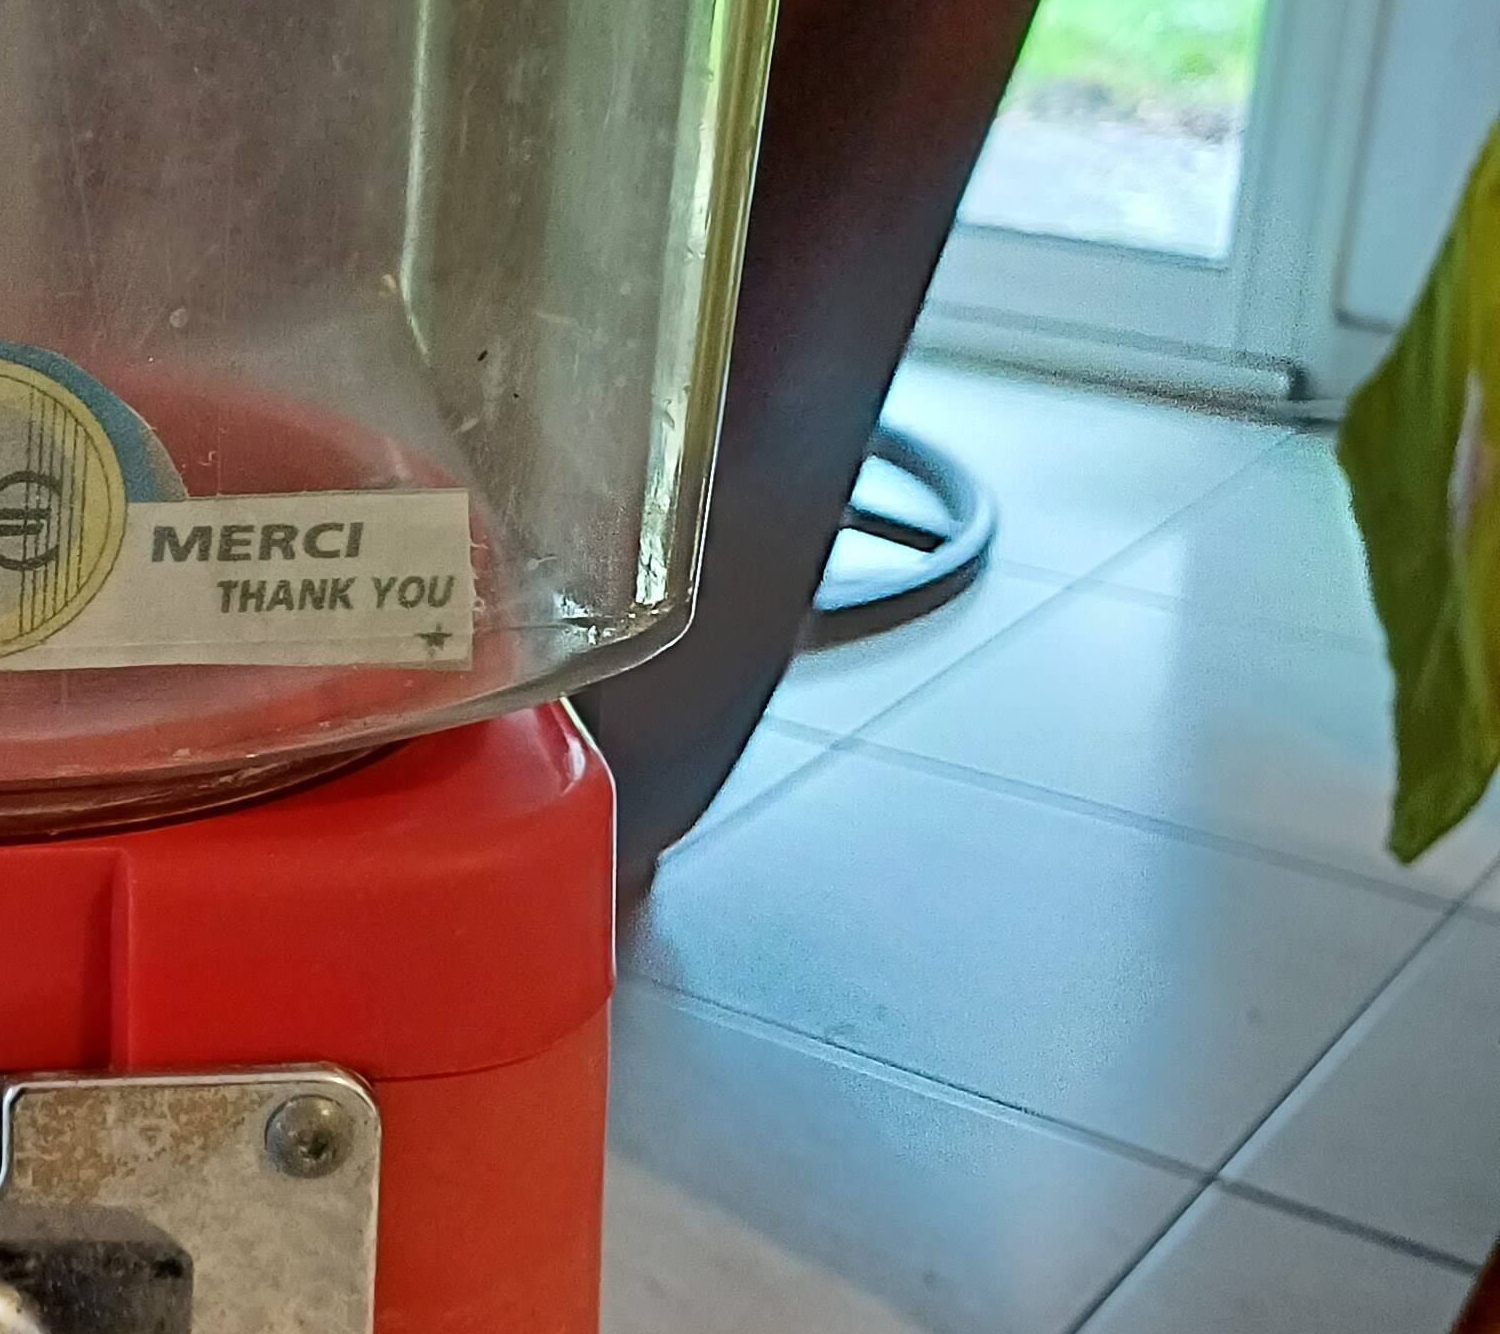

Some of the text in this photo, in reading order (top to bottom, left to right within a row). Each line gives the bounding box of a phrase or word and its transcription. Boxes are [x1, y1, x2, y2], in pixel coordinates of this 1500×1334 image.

[151, 522, 365, 563] MERCI
[217, 575, 456, 613] THANK YOU
